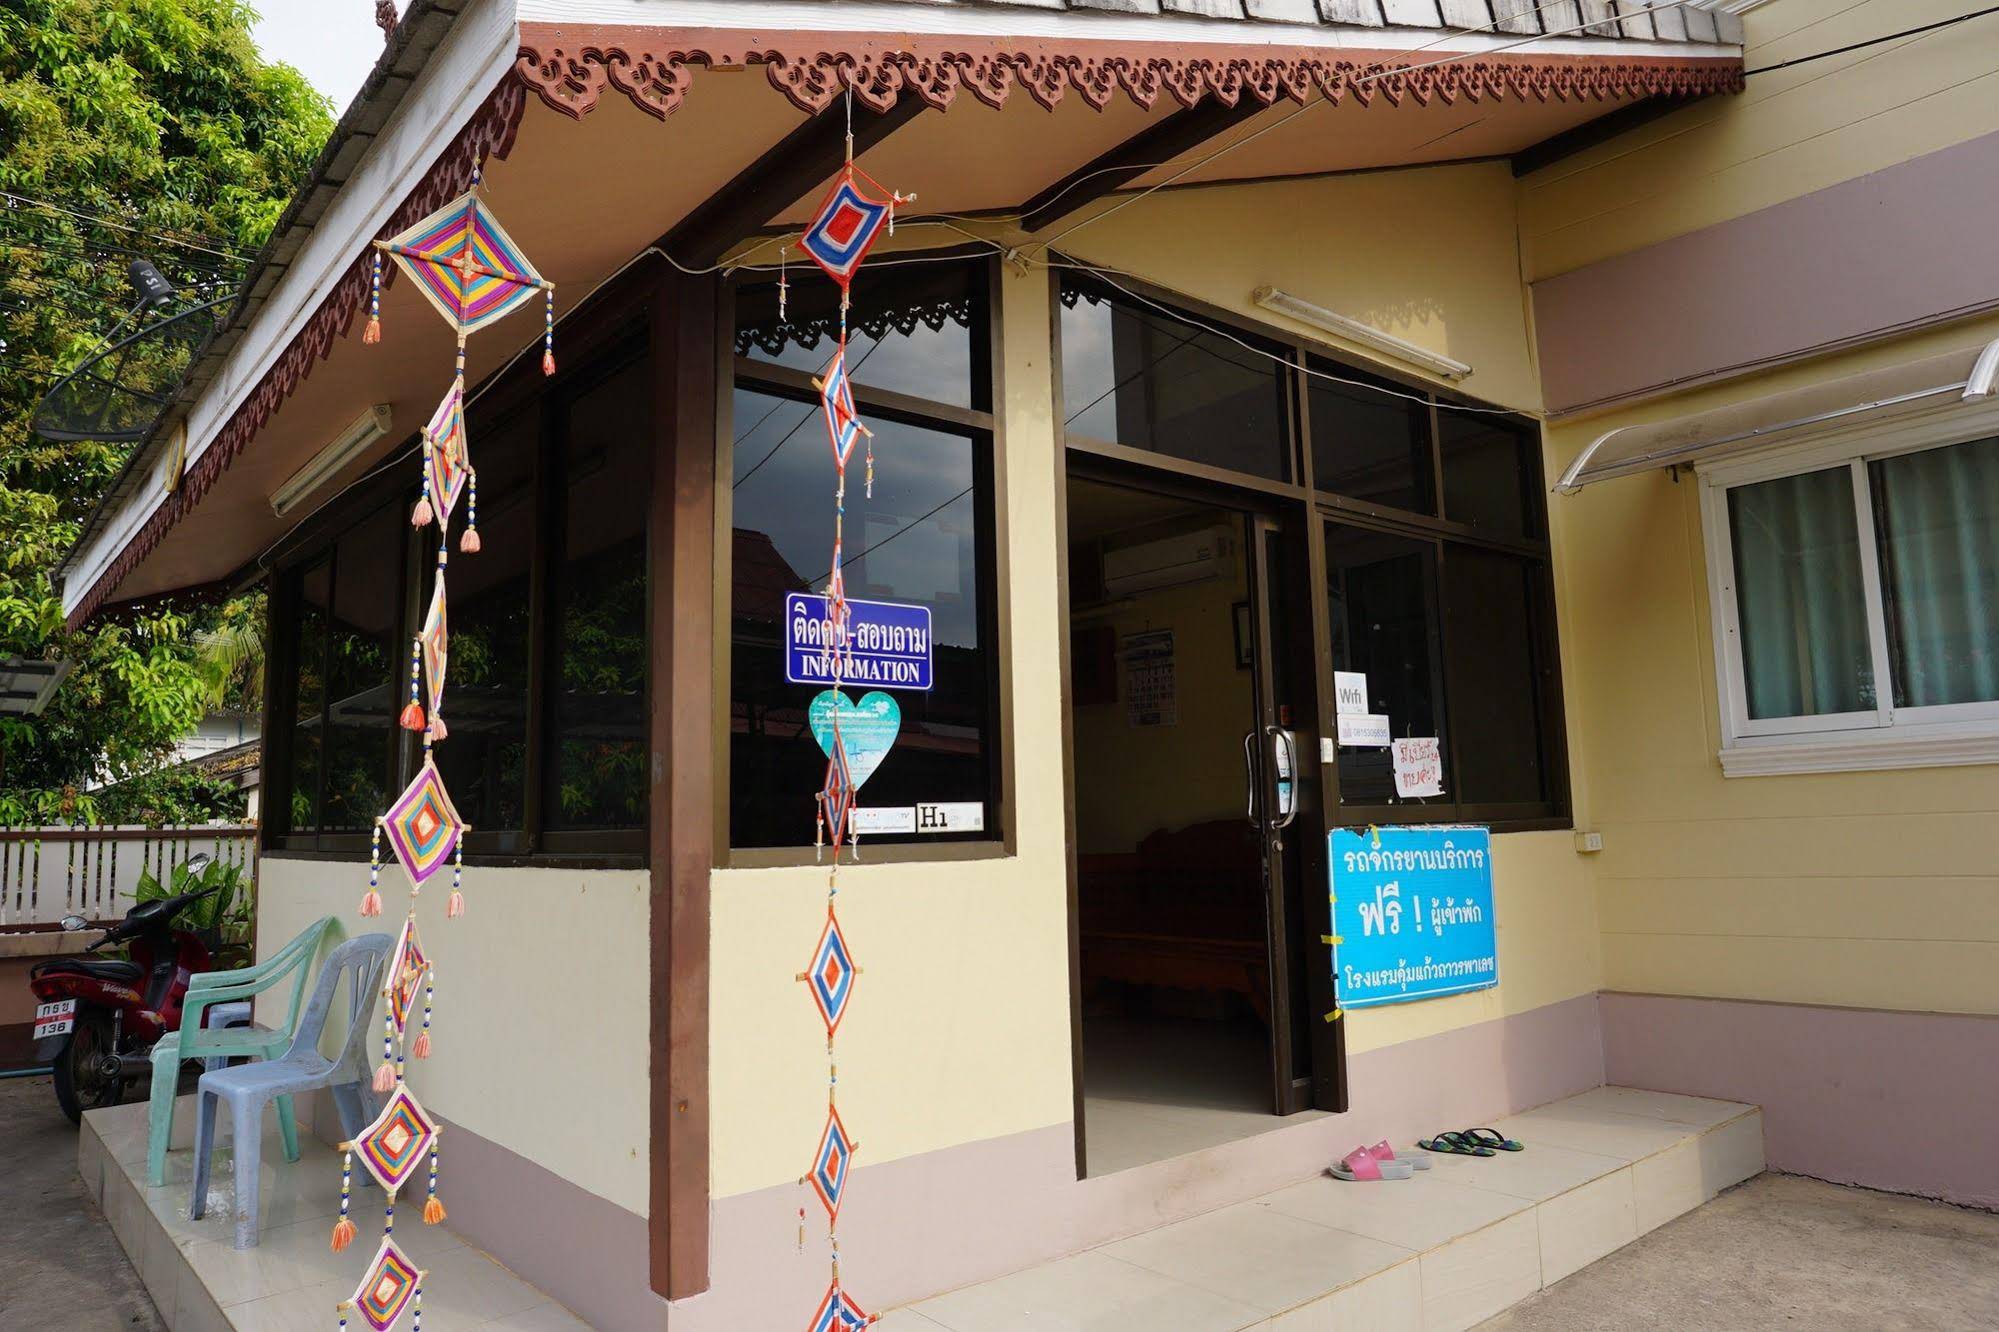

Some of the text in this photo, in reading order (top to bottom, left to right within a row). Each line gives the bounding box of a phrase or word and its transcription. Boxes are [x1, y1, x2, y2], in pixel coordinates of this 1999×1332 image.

[140, 269, 161, 290] PSI
[802, 655, 920, 682] INFORMATION
[1344, 840, 1484, 873] รถจักรยานบริการ
[1358, 880, 1402, 937] ฟรี
[1431, 897, 1482, 936] ผู้เข้าพัก
